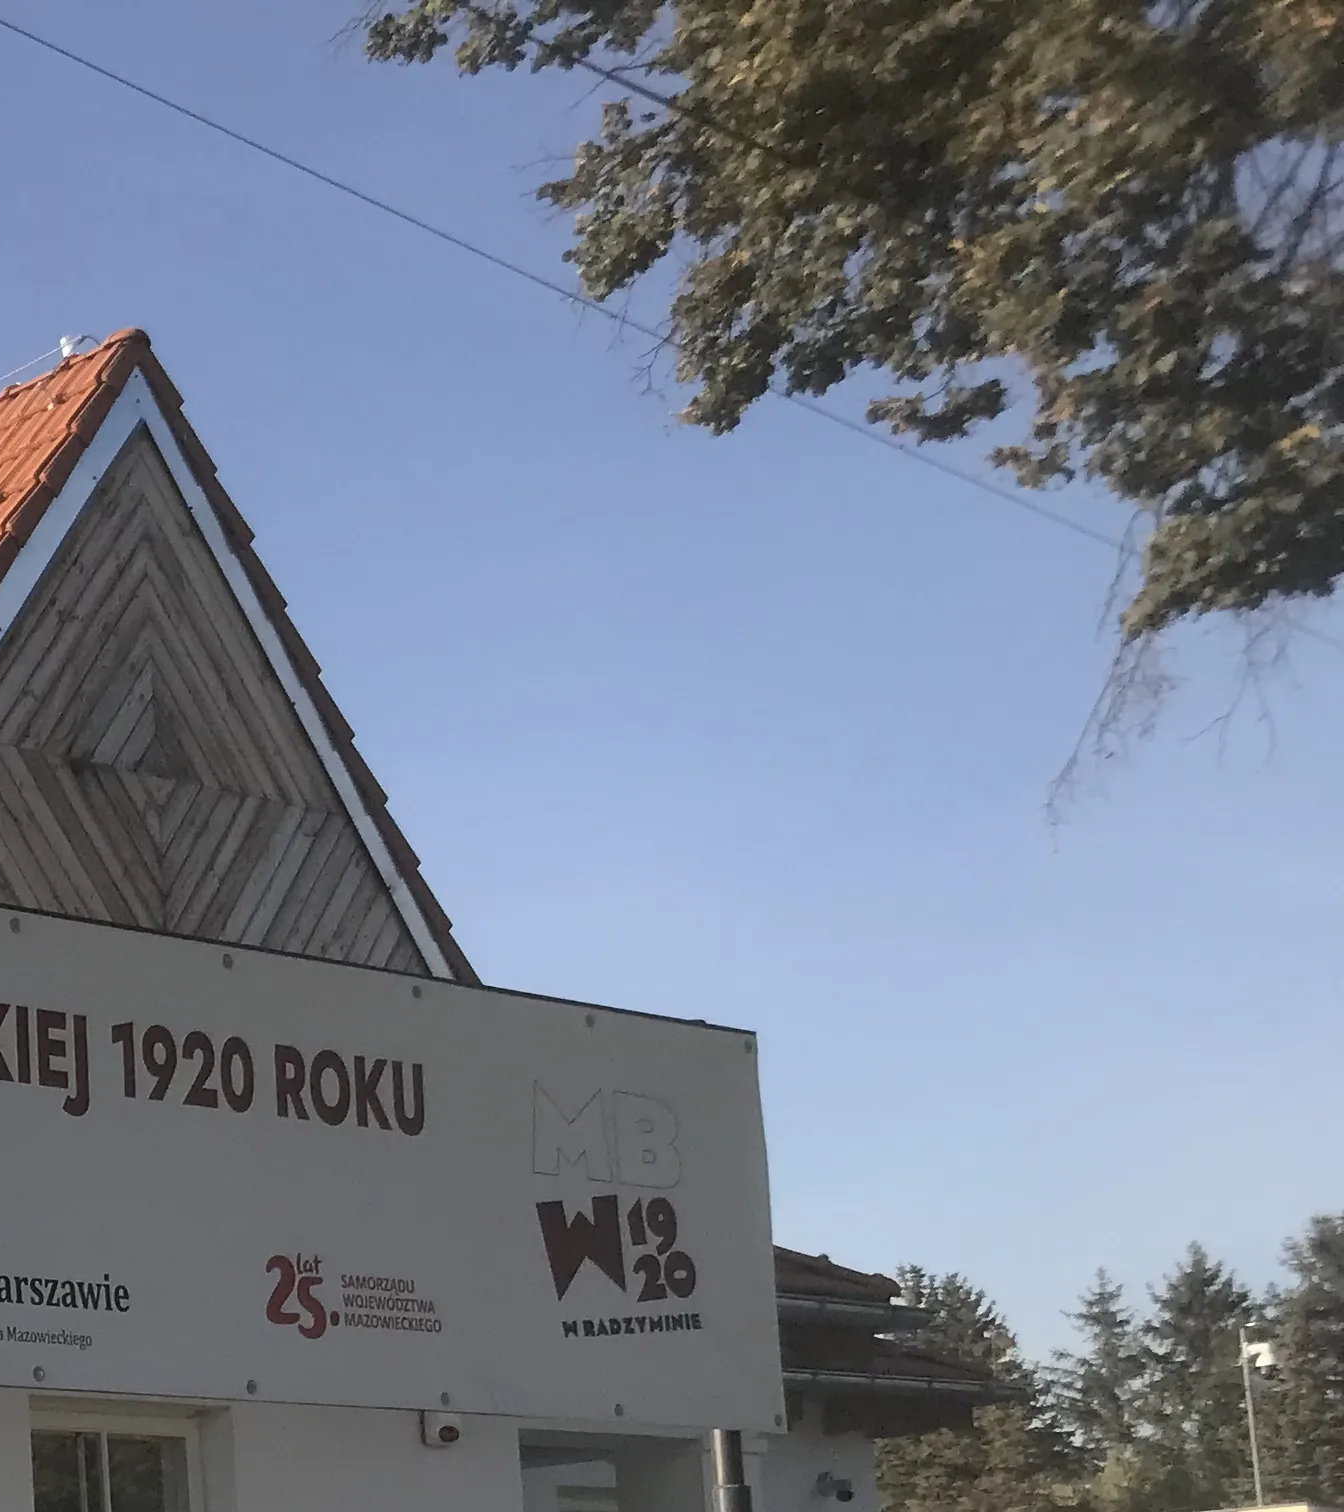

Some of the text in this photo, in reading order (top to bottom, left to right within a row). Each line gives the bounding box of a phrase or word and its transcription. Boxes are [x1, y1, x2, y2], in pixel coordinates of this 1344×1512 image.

[112, 1021, 254, 1113] 1920
[274, 1043, 426, 1137] ROKU
[296, 1252, 322, 1275] lat
[340, 1274, 415, 1295] SAMORZĄDU
[342, 1293, 435, 1314] WOJEWÓDZTWA
[344, 1311, 442, 1333] MAZOWIECKIEGO
[561, 1312, 703, 1338] W RADZYMINIE
[7, 1326, 93, 1351] Mazowieckiego
